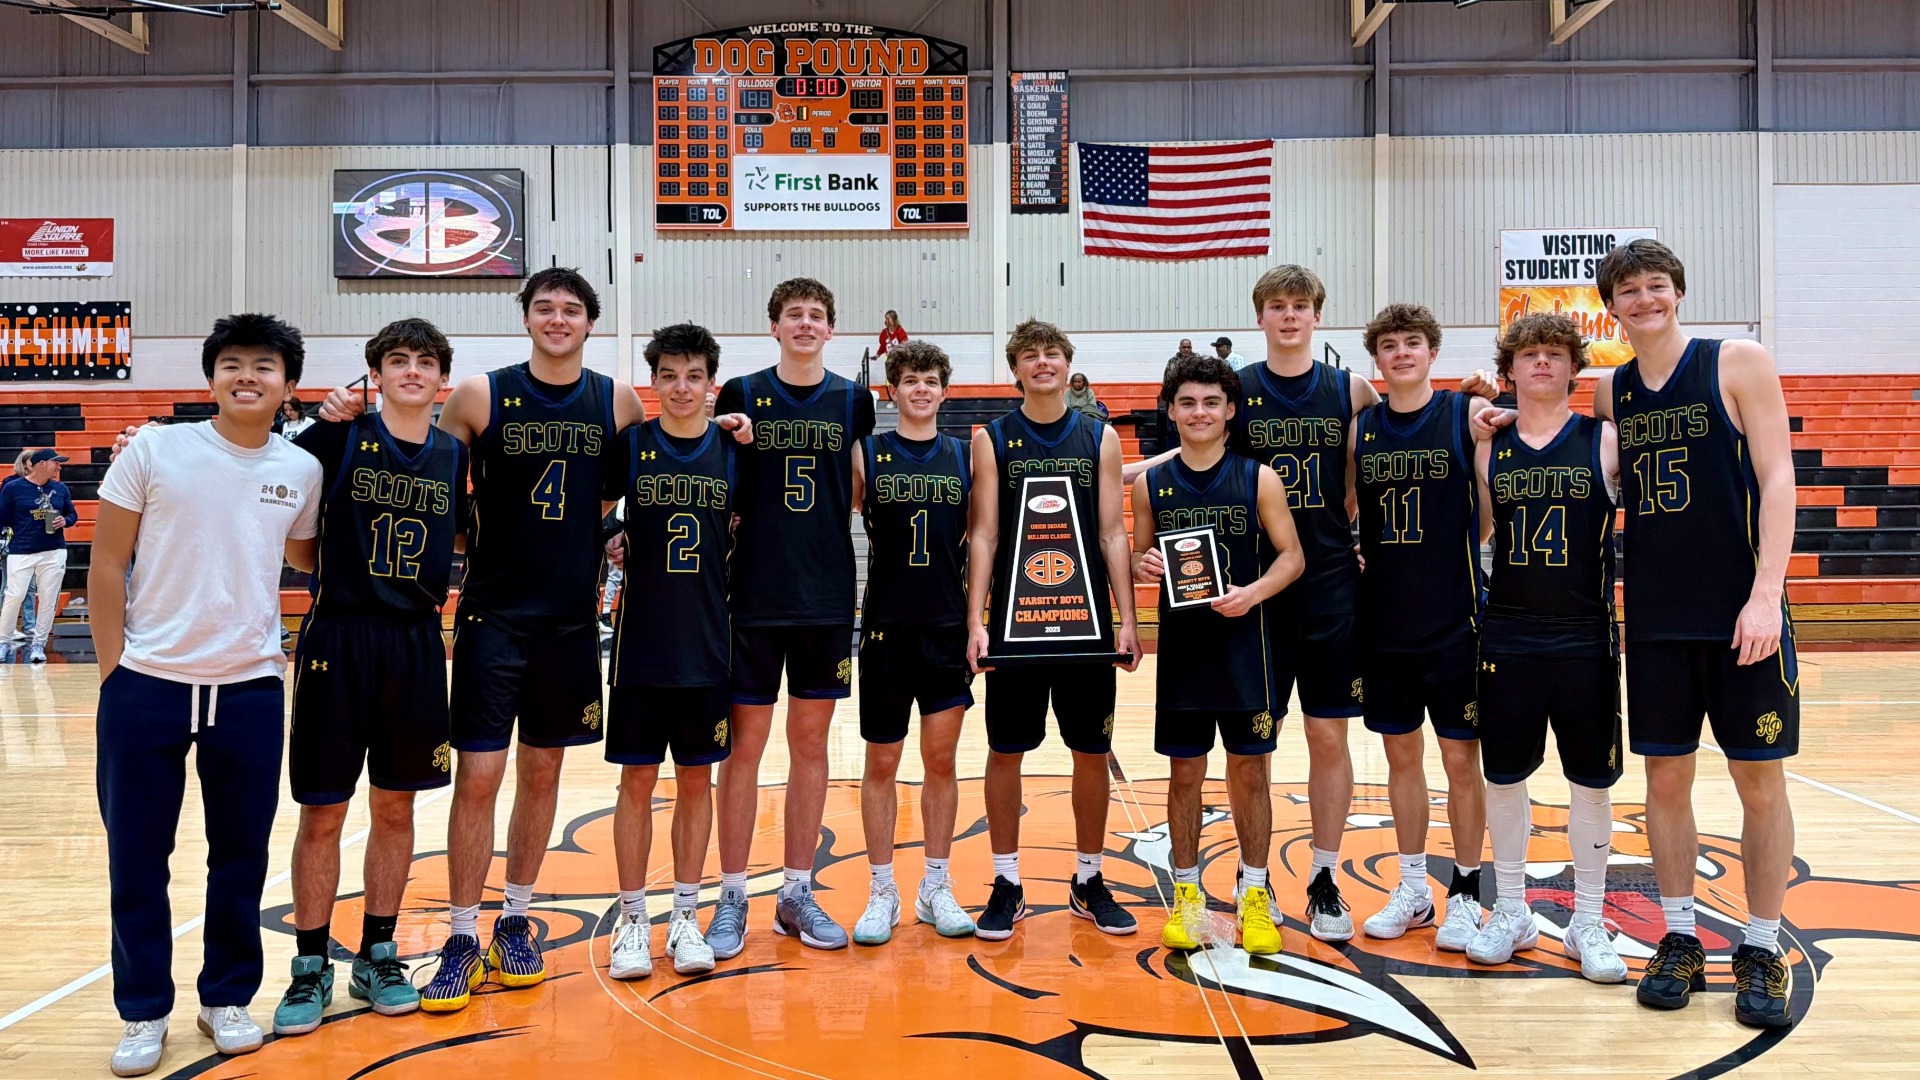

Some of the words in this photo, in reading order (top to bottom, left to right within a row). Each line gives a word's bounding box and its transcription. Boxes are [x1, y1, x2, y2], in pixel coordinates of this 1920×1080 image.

[749, 23, 818, 35] WELCOME
[823, 23, 841, 33] TO
[845, 24, 873, 35] THE
[693, 38, 775, 75] DOG
[785, 38, 929, 75] POUND
[738, 79, 774, 88] BULLDOGS
[796, 79, 838, 95] 0:00
[852, 79, 882, 87] VISITOR
[1049, 72, 1066, 80] DOGS
[775, 173, 822, 190] First
[828, 173, 879, 190] Bank
[703, 208, 722, 220] TOL
[744, 202, 799, 212] SUPPORTS
[801, 203, 821, 212] THE
[824, 202, 880, 212] BULLDOGS
[903, 208, 922, 220] TOL
[44, 232, 84, 241] SQUARE
[47, 225, 80, 233] UNION
[1505, 258, 1580, 280] STUDENT
[503, 421, 603, 456] SCOTS
[756, 419, 843, 452] SCOTS
[1248, 417, 1342, 449] SCOTS
[1619, 403, 1708, 449] SCOTS
[1269, 452, 1325, 509] 21
[1361, 449, 1449, 484] SCOTS
[1633, 446, 1690, 516] 15
[261, 485, 274, 495] 24
[289, 490, 298, 499] 25
[351, 467, 450, 515] SCOTS
[531, 459, 566, 520] 4
[637, 473, 728, 509] SCOTS
[784, 455, 816, 512] 5
[876, 473, 961, 505] SCOTS
[1494, 467, 1591, 503] SCOTS
[259, 498, 297, 509] BASKETBALL
[1380, 487, 1423, 544] 11
[1159, 505, 1247, 535] SCOTS
[1509, 505, 1568, 567] 14
[369, 513, 427, 579] 12
[667, 513, 700, 573] 2
[909, 510, 929, 566] 1
[1015, 608, 1089, 623] CHAMPIONS
[1019, 596, 1059, 606] VARSITY
[1060, 595, 1084, 604] BOYS
[1756, 711, 1782, 744] HP
